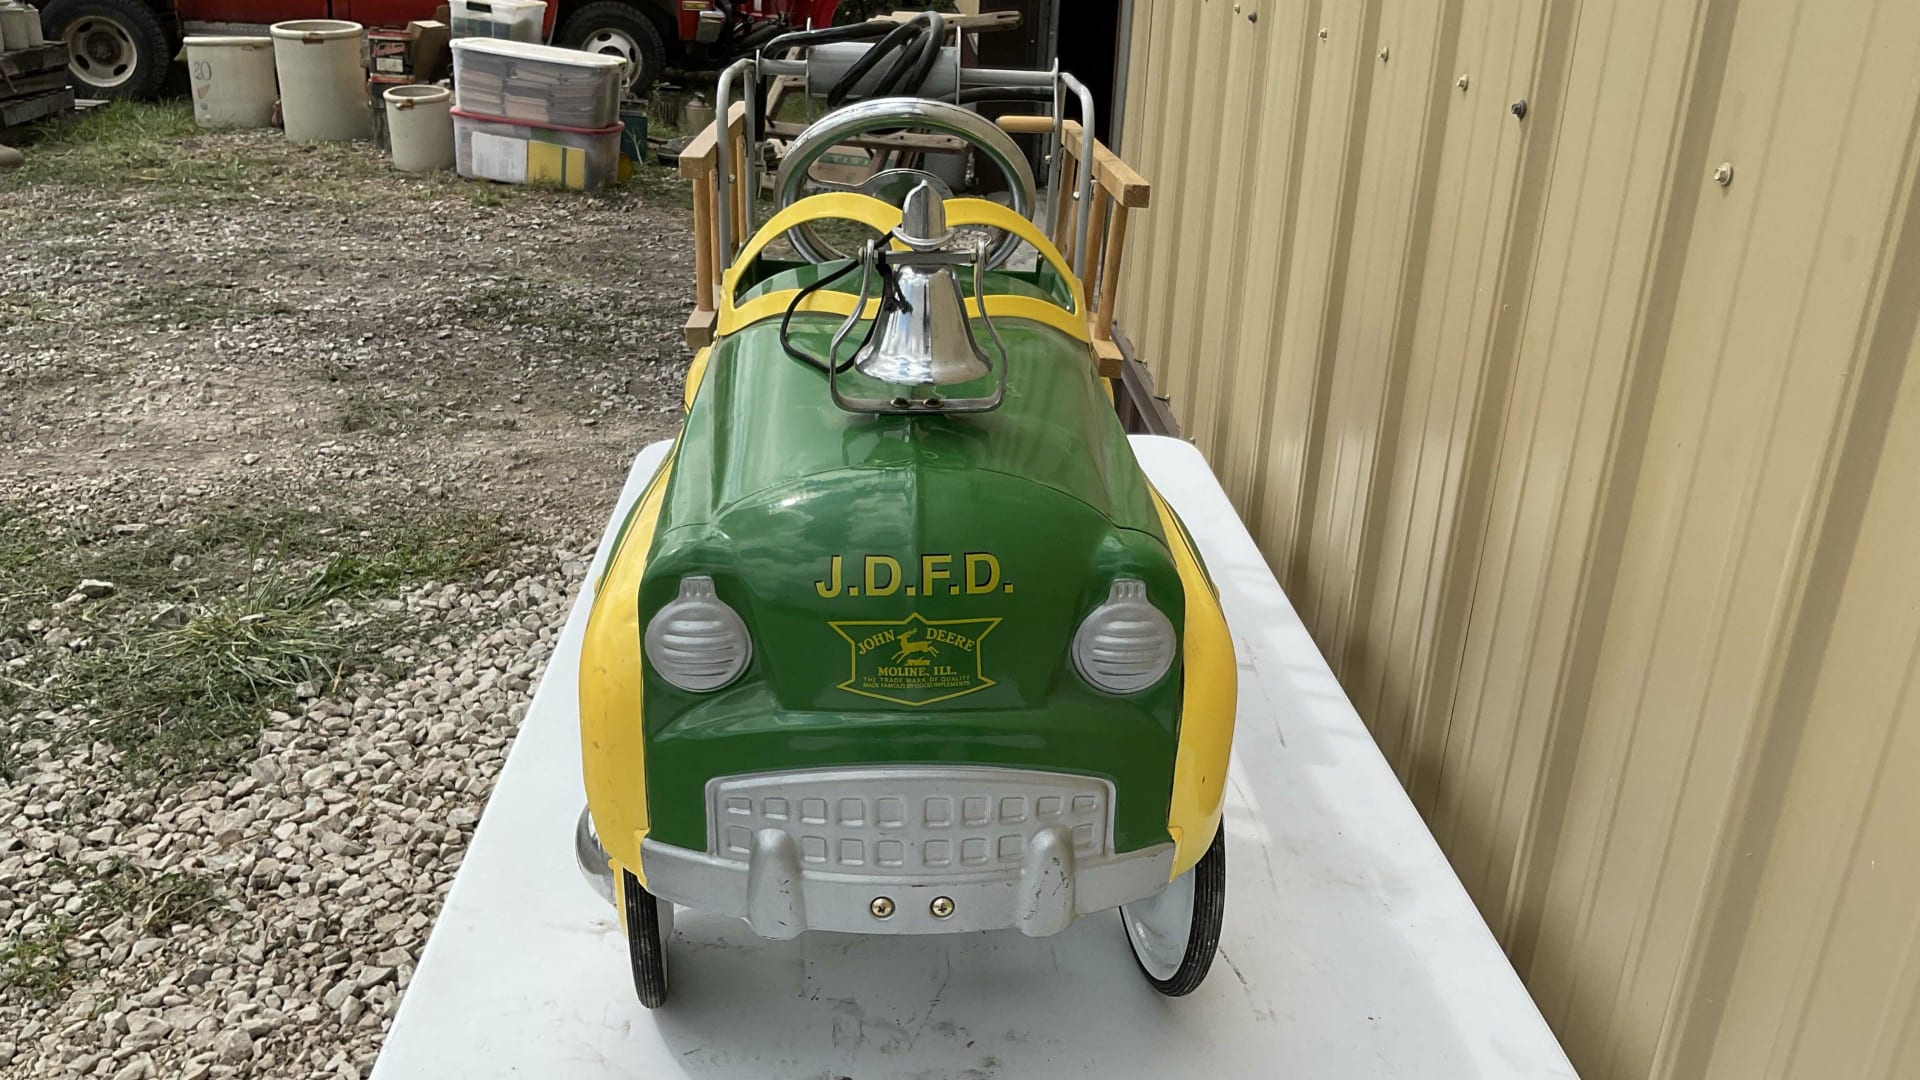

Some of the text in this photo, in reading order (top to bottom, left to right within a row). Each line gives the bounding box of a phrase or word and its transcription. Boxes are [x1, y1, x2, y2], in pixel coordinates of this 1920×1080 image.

[193, 60, 212, 81] 20
[815, 552, 1014, 599] J.D.F.D.
[857, 627, 975, 655] JOHN DEERE
[933, 666, 957, 676] ILL.
